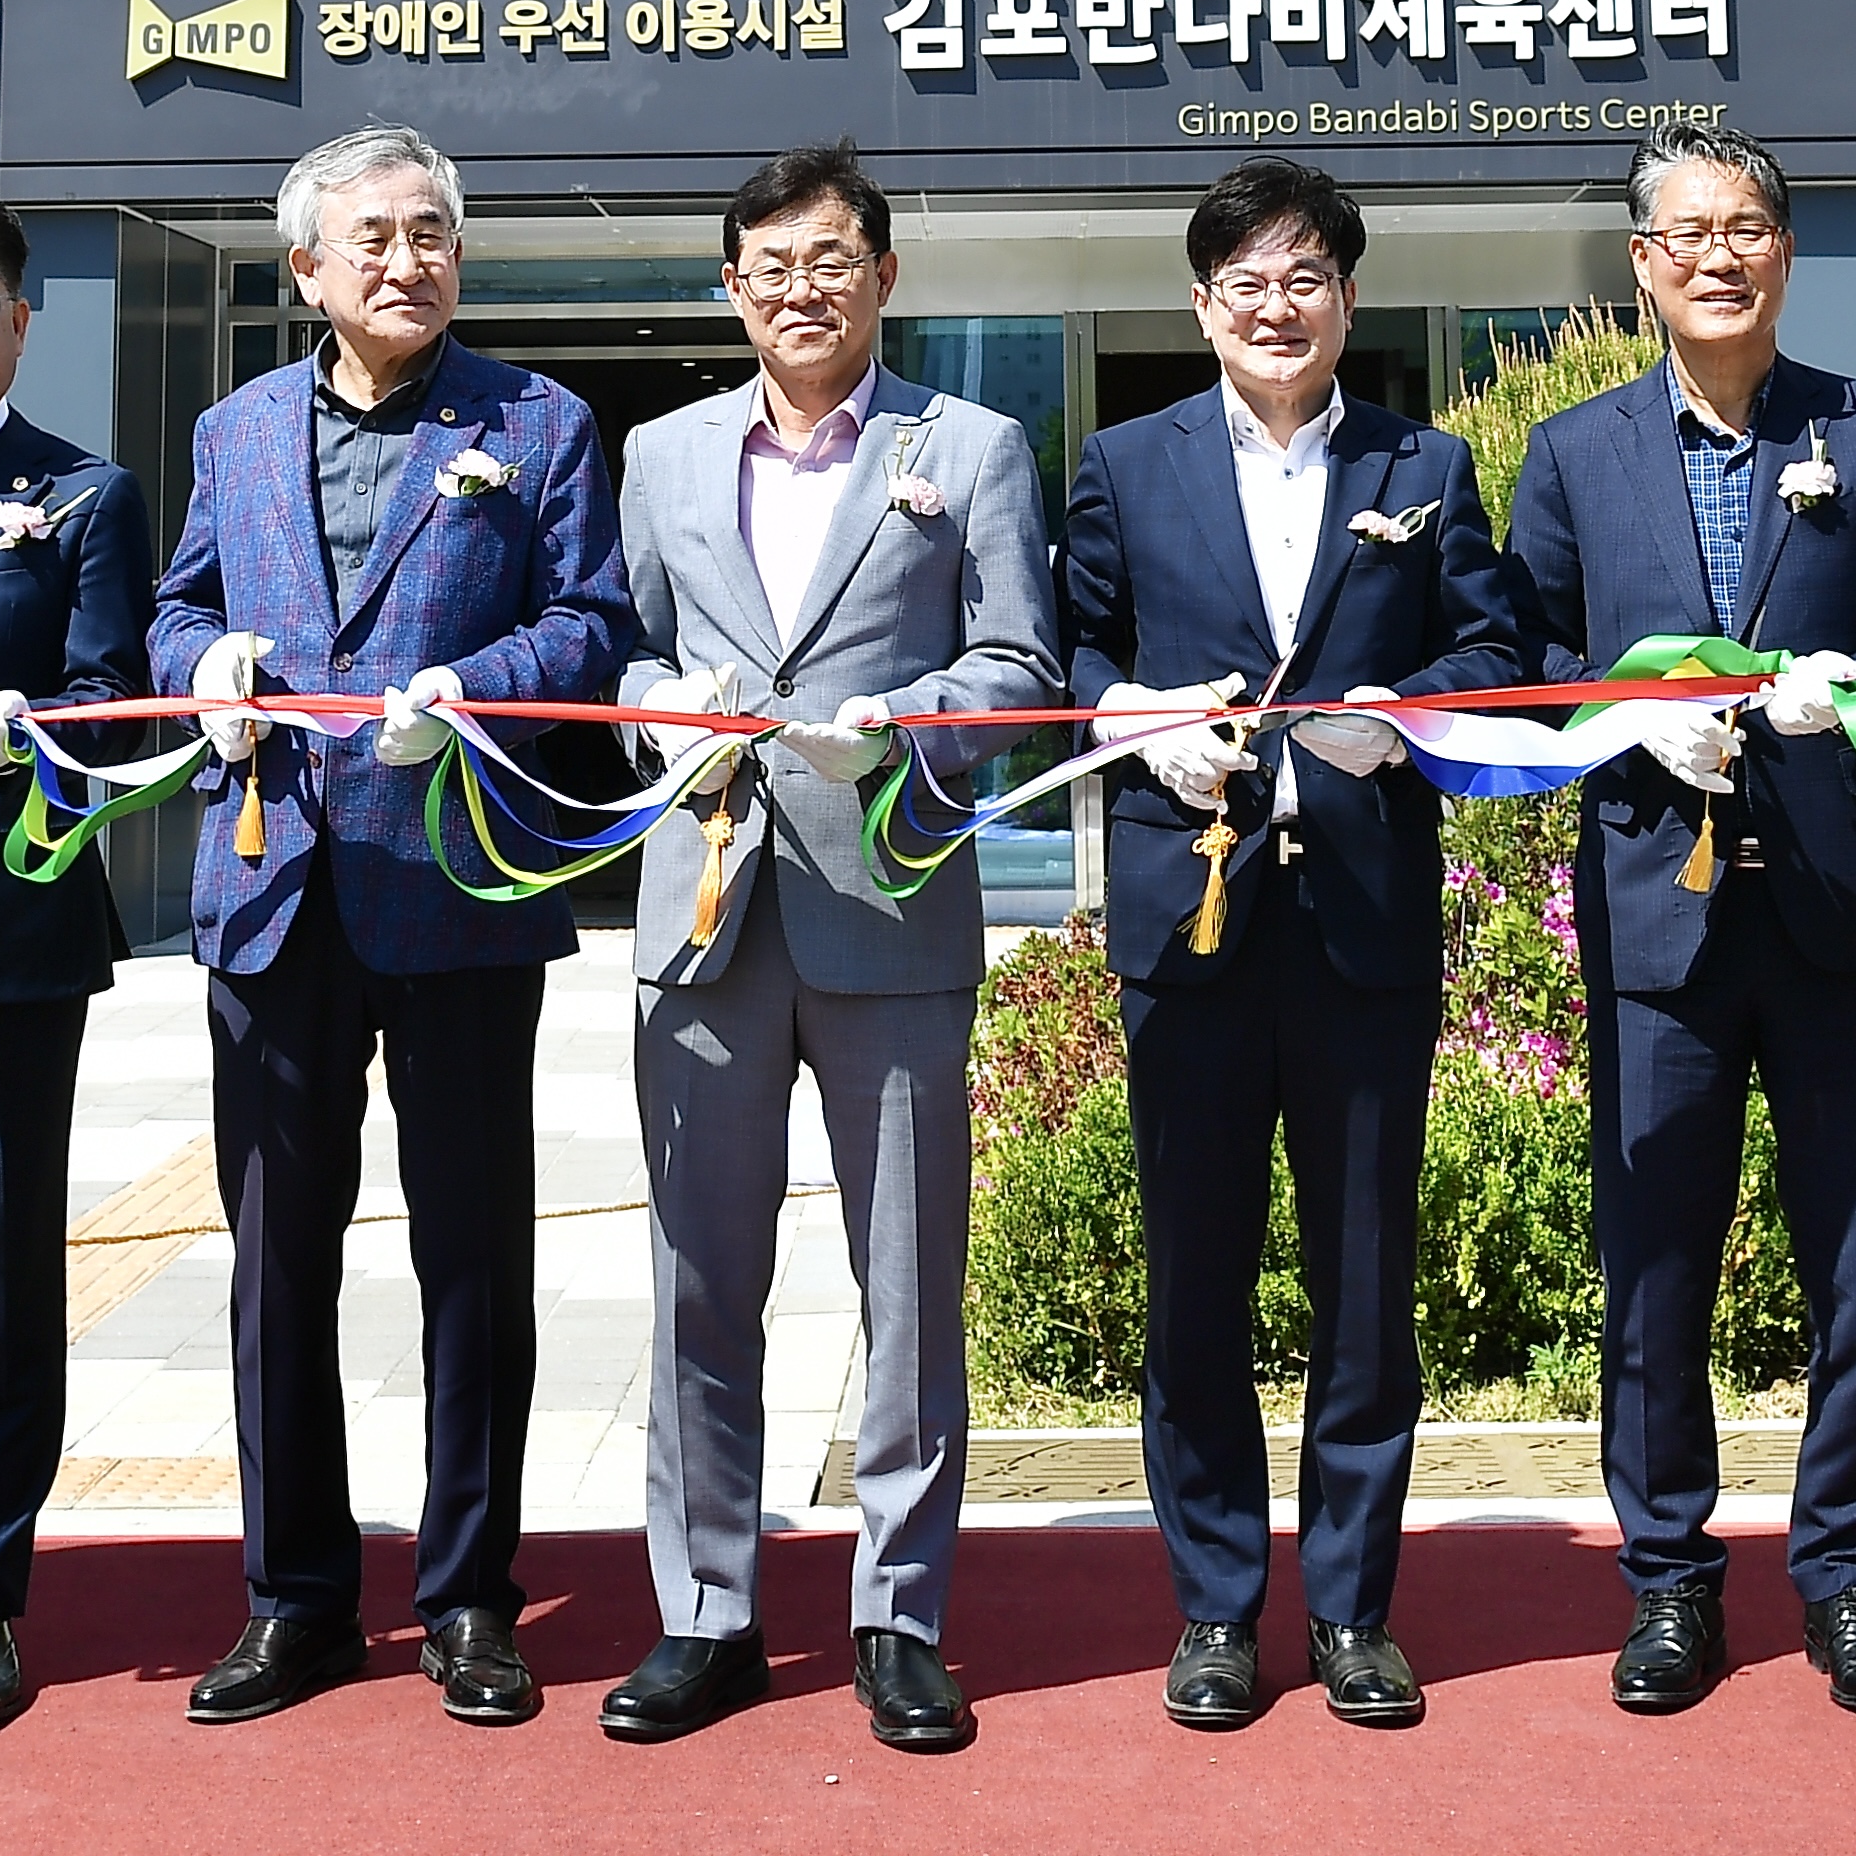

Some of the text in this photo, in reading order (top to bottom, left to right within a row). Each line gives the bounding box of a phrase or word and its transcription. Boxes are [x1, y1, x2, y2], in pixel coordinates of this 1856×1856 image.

[316, 0, 482, 56] 장애인
[1177, 99, 1728, 142] Gimpo Bandabi Sports Center
